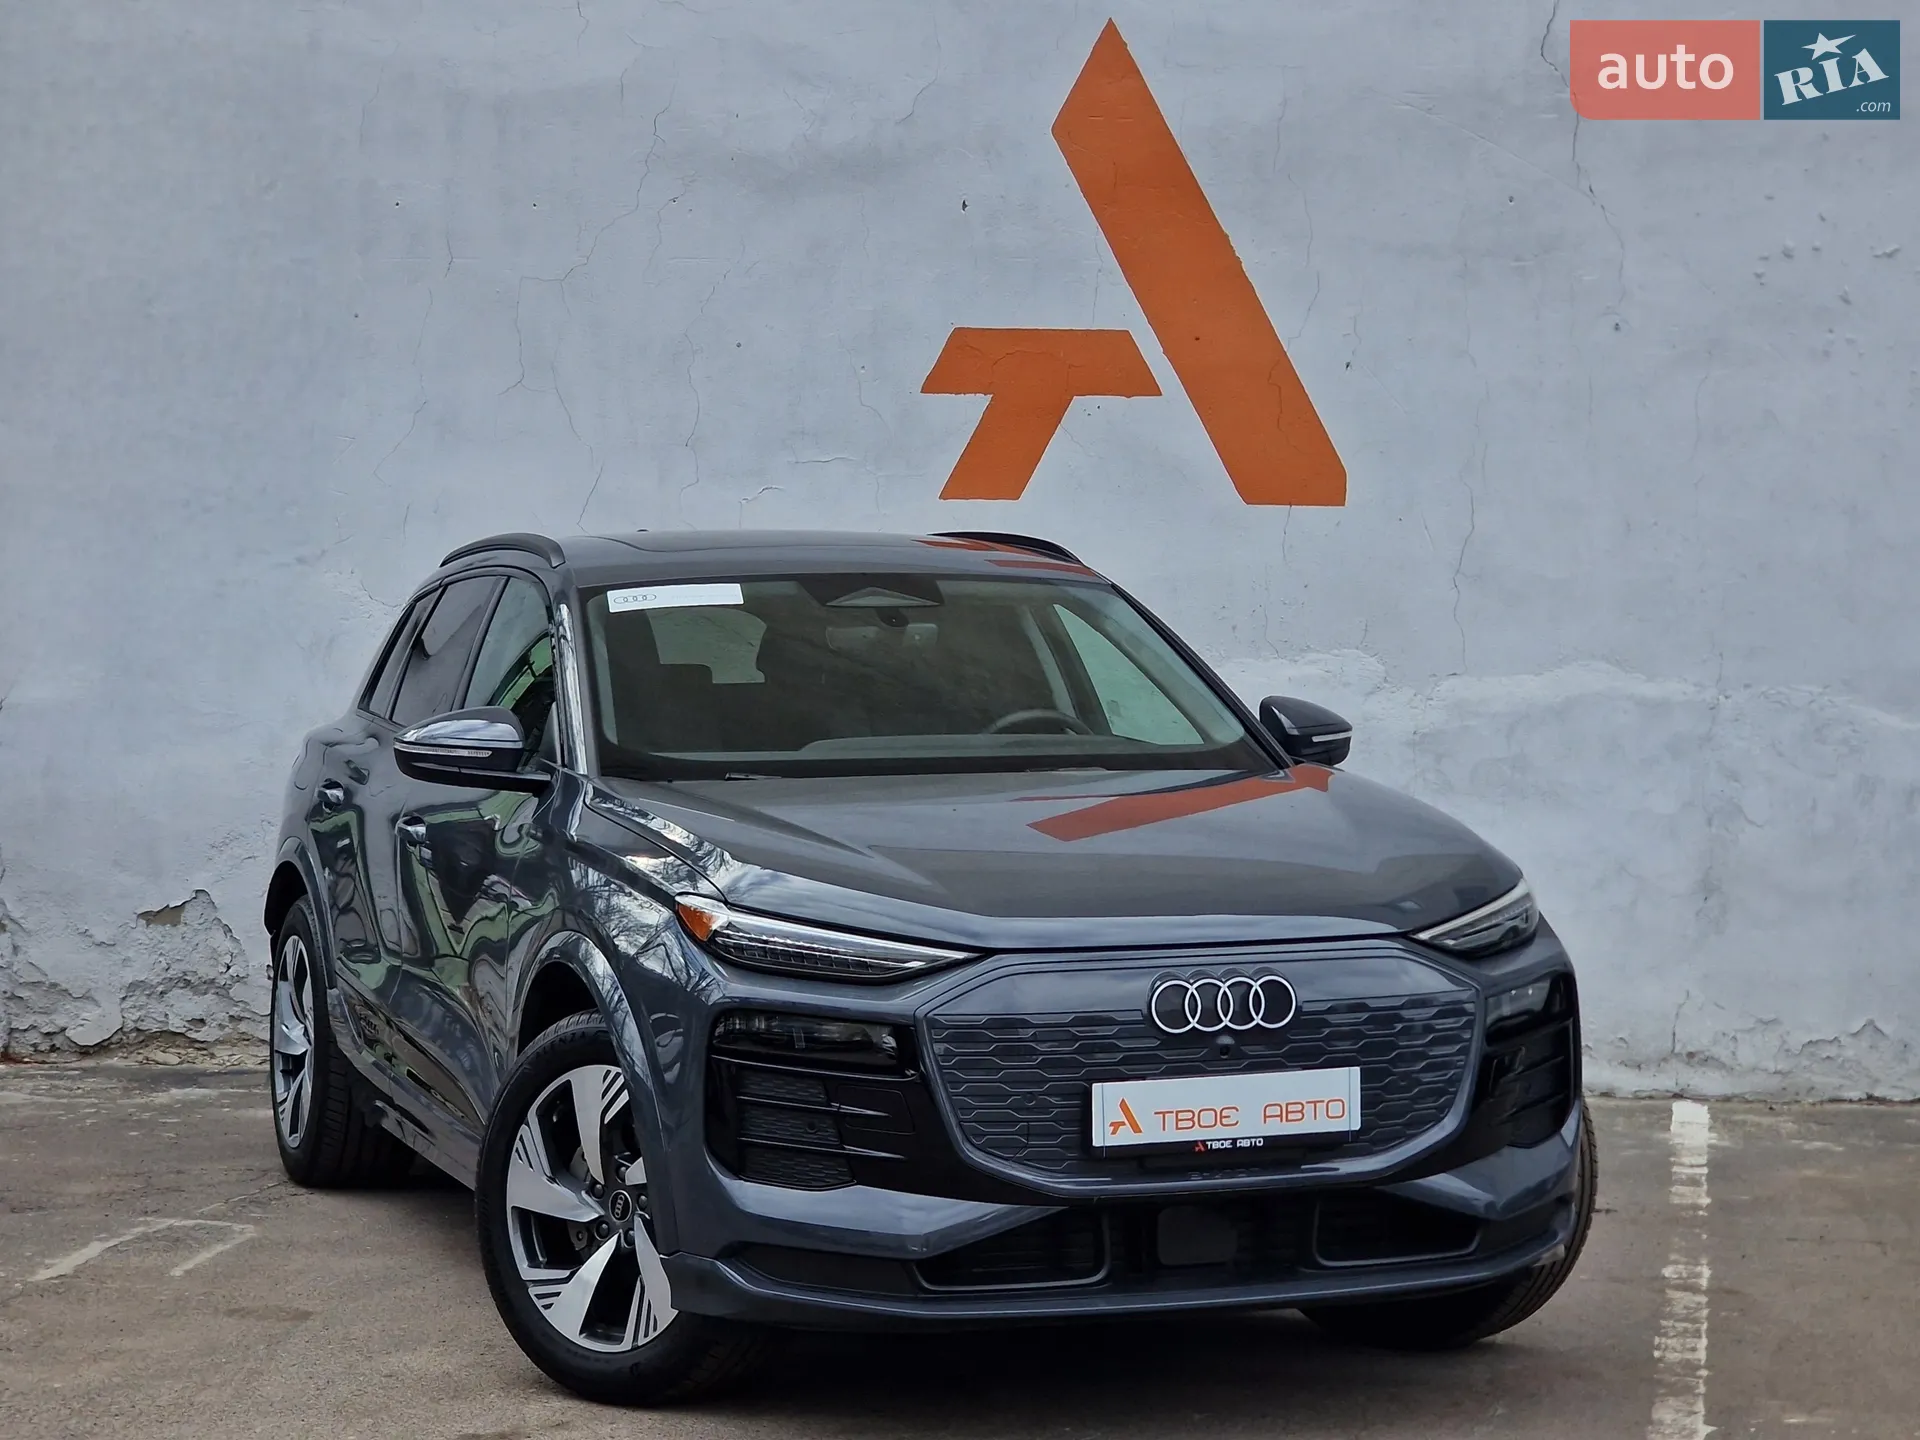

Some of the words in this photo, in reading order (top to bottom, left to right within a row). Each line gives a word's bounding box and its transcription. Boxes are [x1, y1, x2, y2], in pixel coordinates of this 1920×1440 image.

[1153, 1106, 1240, 1132] ТВОЄ
[1263, 1098, 1346, 1125] АВТО
[1236, 1138, 1264, 1148] АВТО
